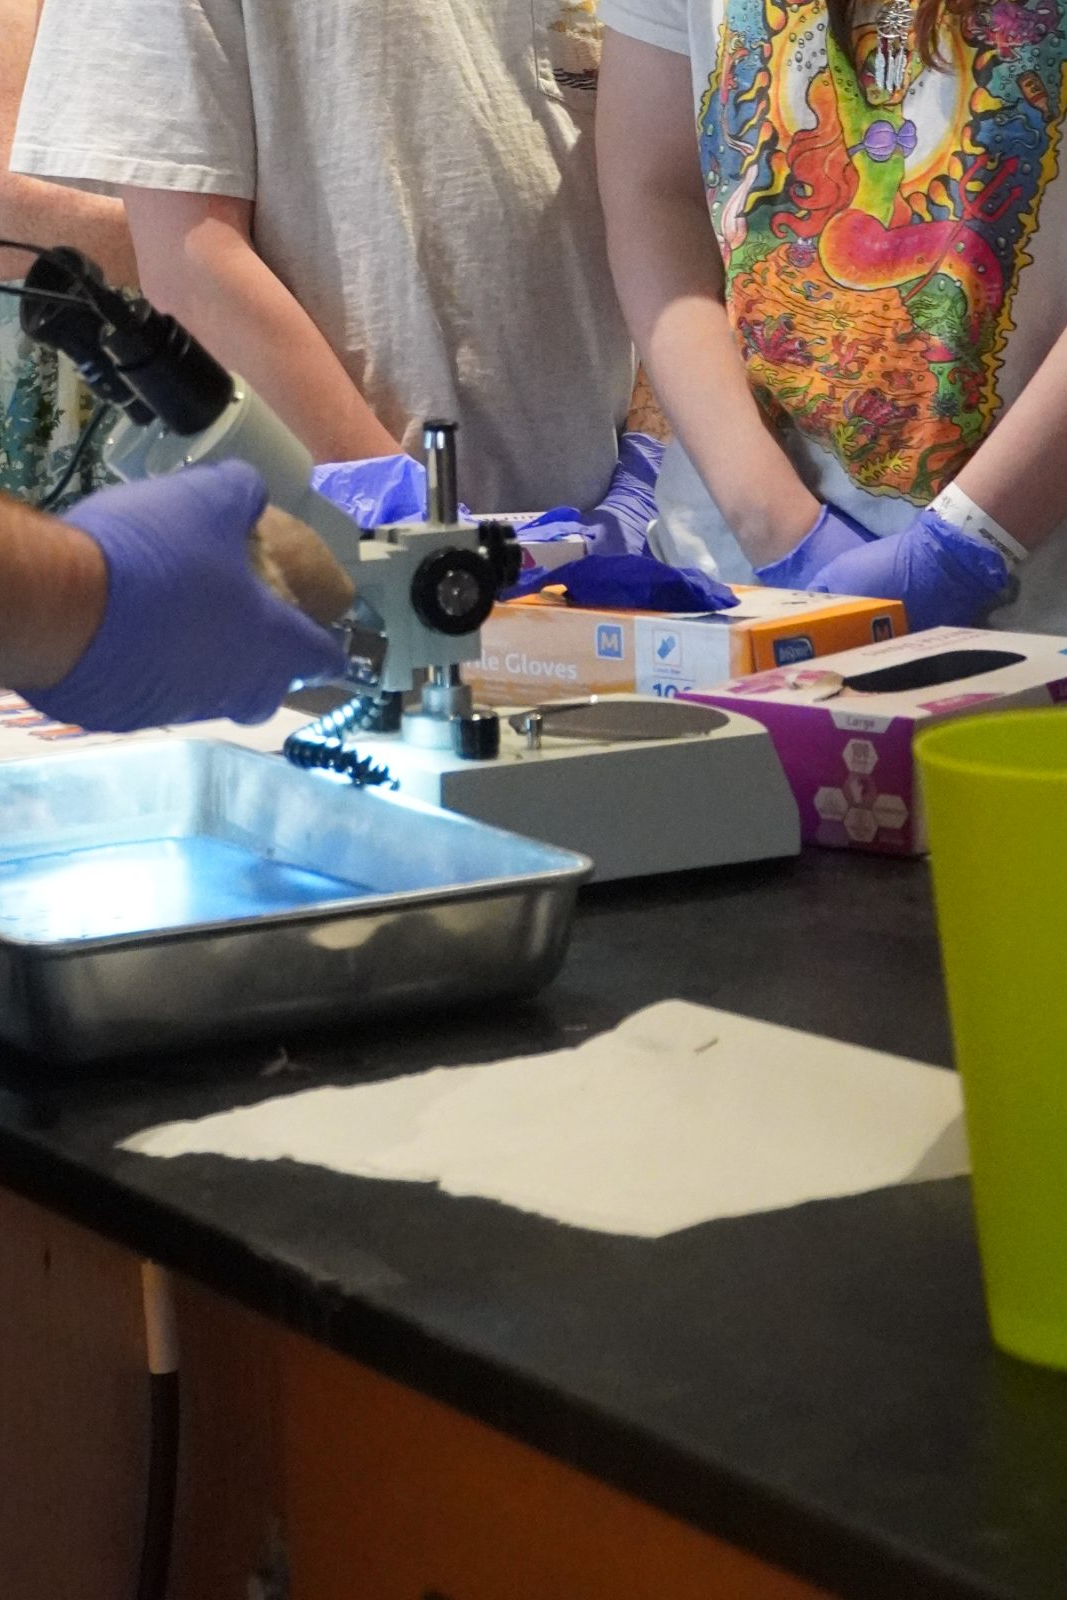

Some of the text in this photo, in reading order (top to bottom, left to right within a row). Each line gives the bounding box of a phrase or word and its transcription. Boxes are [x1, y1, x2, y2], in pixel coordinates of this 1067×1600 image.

[600, 631, 619, 652] M
[505, 652, 578, 680] Gloves
[652, 682, 692, 699] 10
